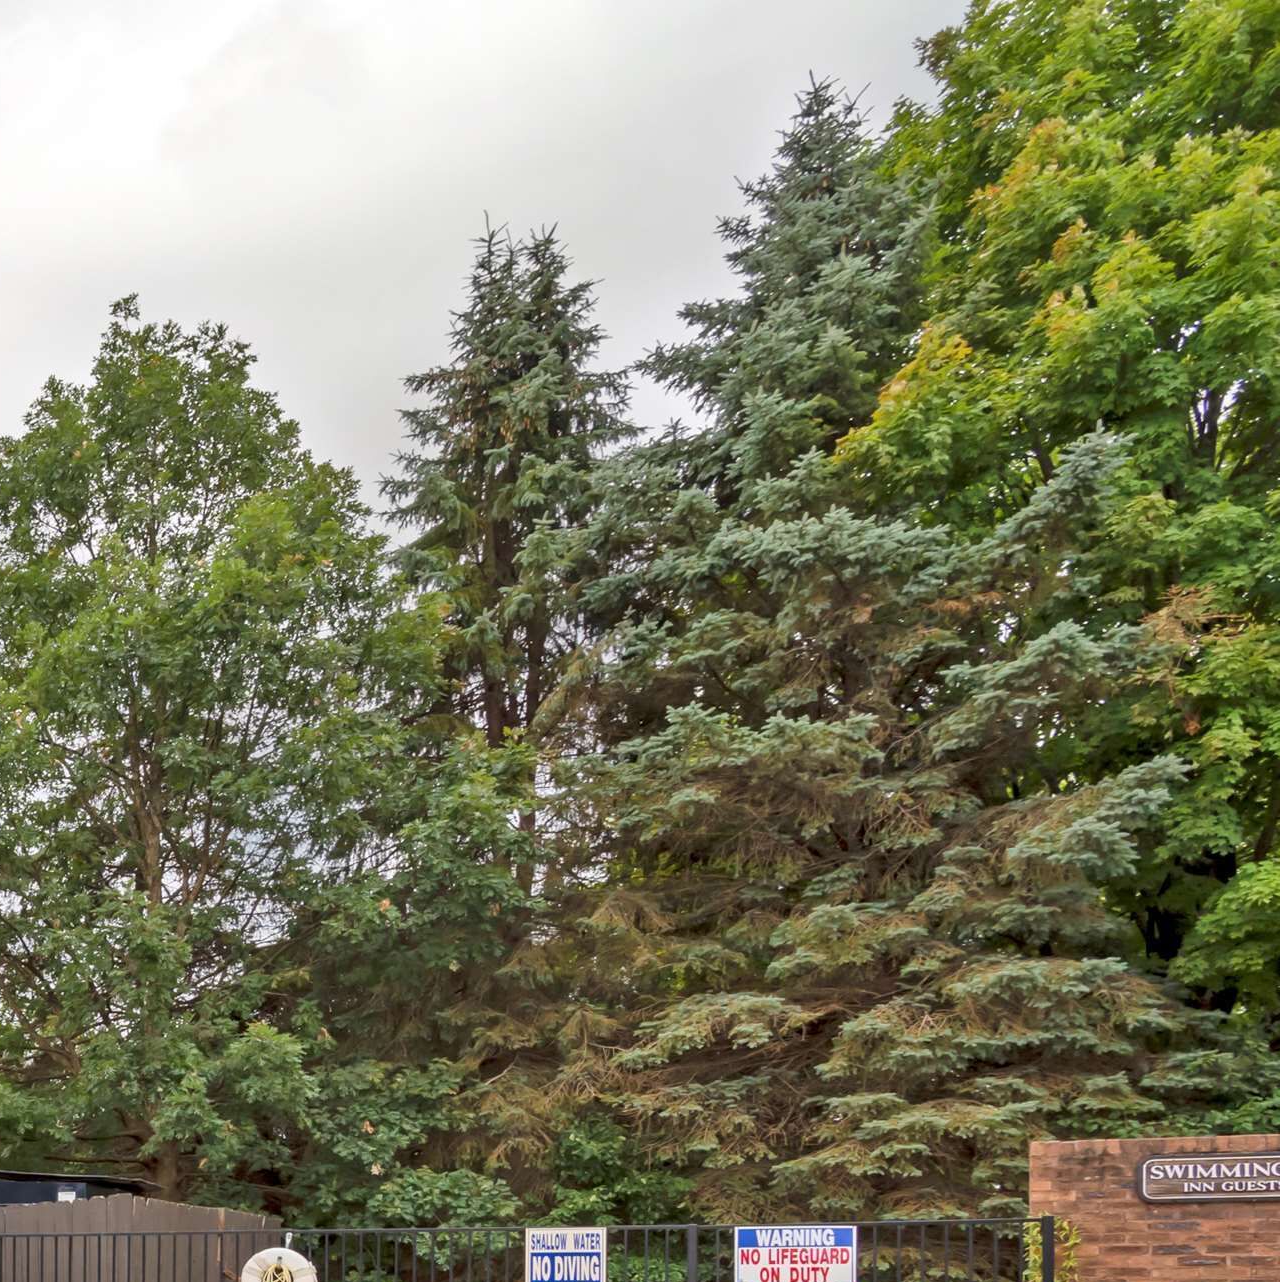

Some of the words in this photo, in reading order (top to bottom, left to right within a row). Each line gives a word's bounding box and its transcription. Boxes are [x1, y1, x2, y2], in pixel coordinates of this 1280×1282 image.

[1184, 1182, 1215, 1193] INN
[1222, 1180, 1280, 1192] GUEST
[531, 1233, 567, 1250] SHALLOW
[573, 1233, 600, 1250] WATER
[755, 1229, 835, 1247] WARNING
[741, 1249, 761, 1265] NO
[768, 1248, 850, 1265] LIFEGUARD
[532, 1255, 552, 1281] NO
[554, 1255, 600, 1281] DIVING
